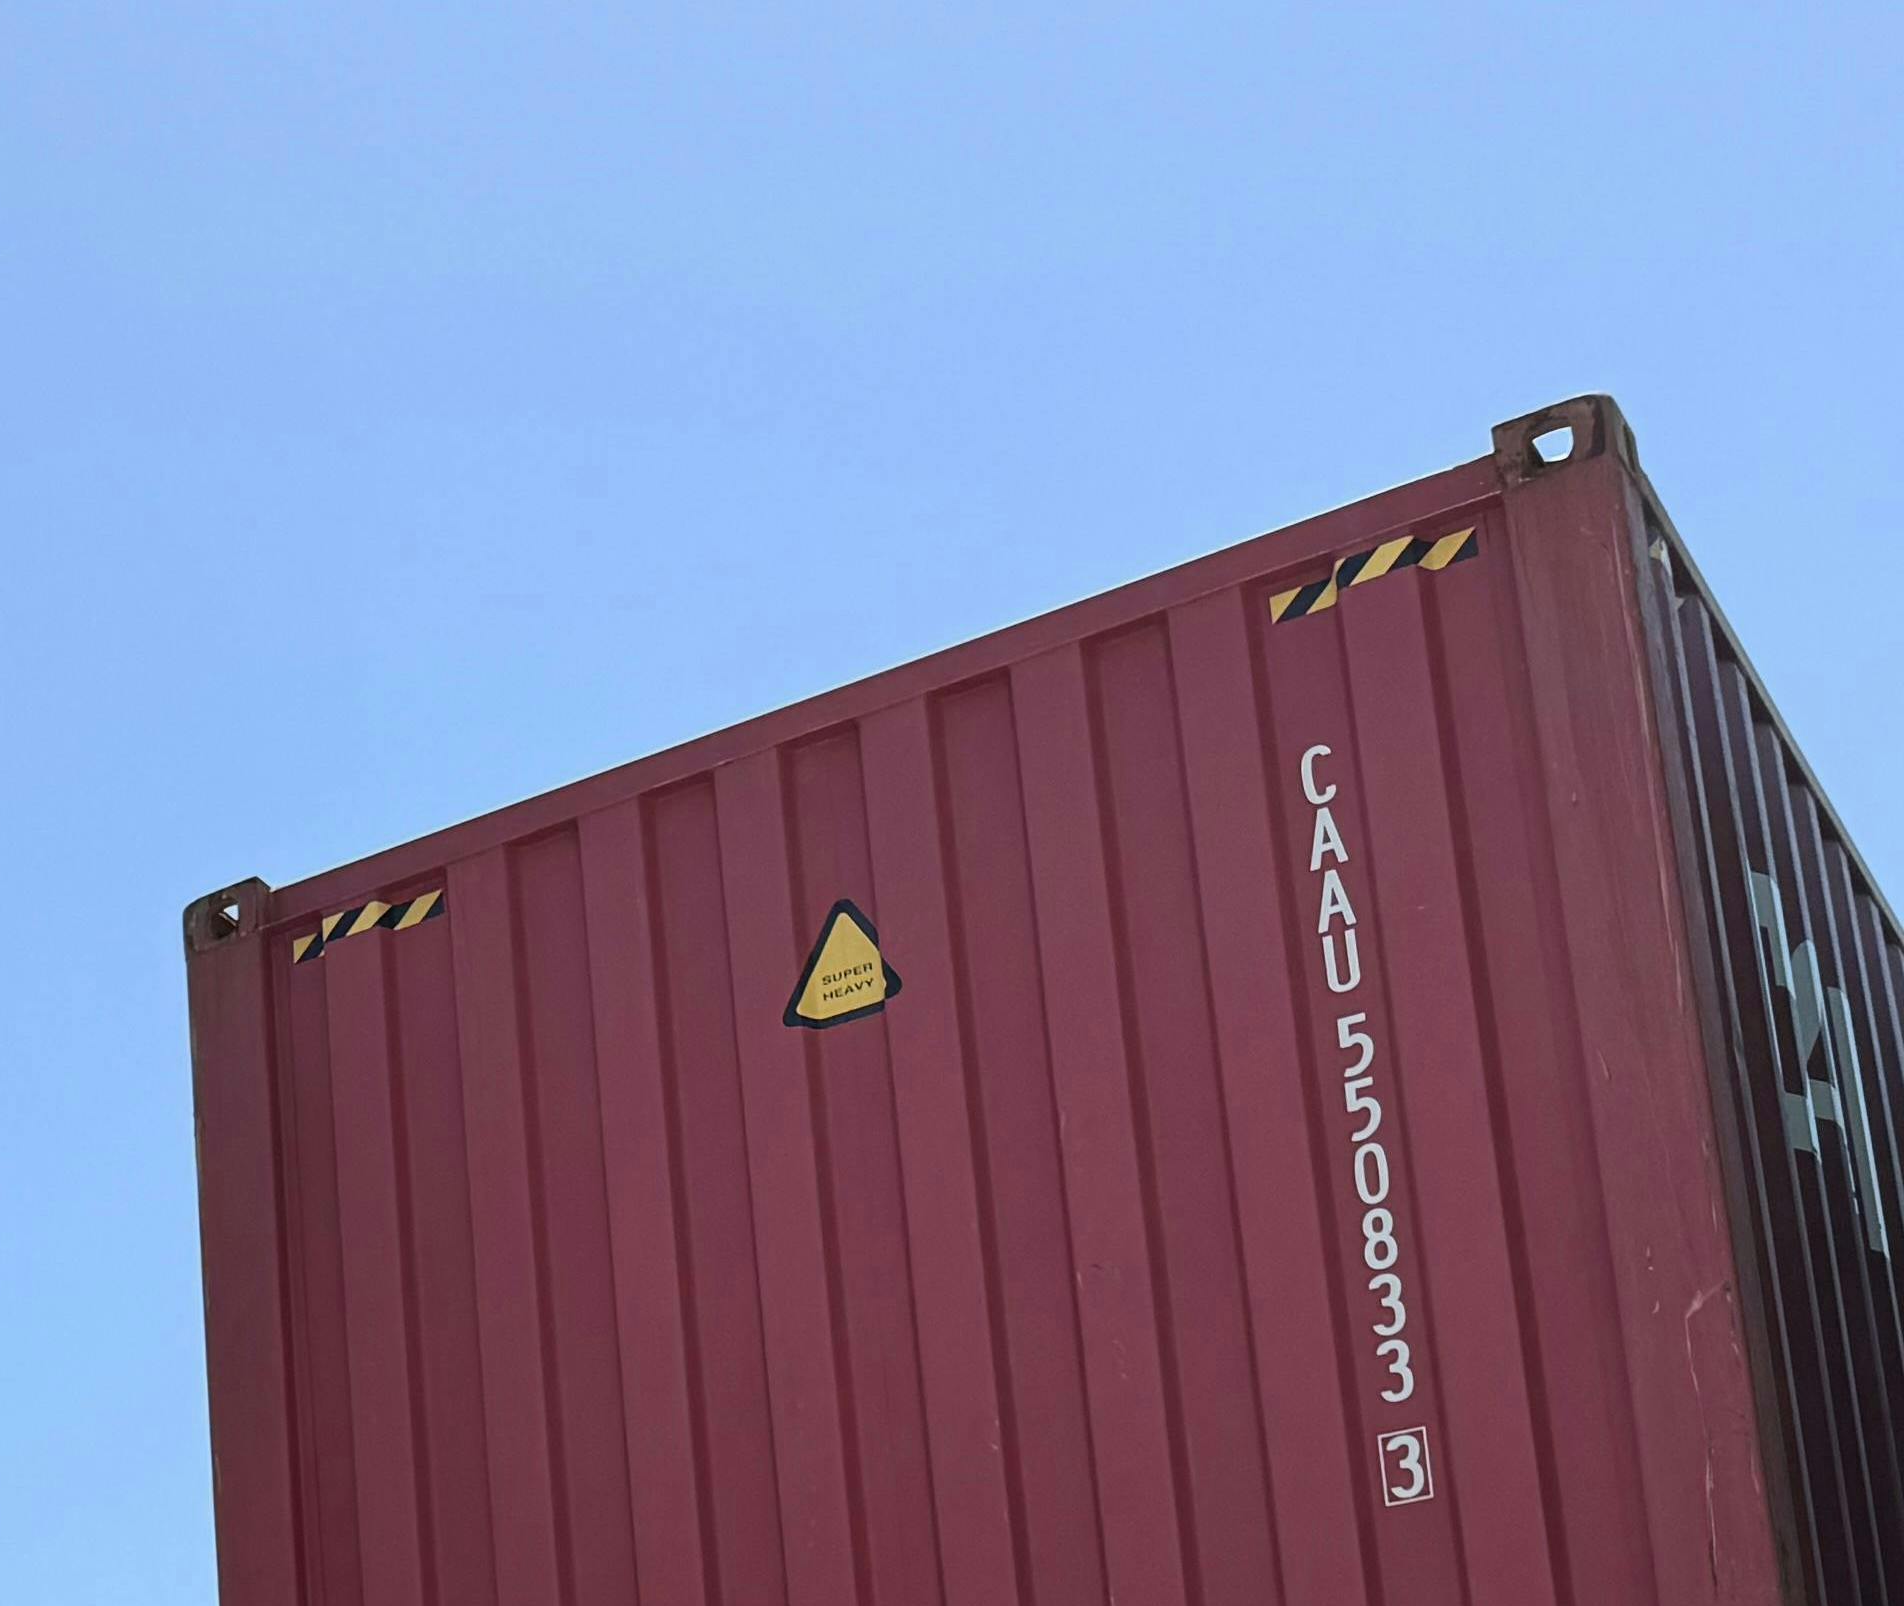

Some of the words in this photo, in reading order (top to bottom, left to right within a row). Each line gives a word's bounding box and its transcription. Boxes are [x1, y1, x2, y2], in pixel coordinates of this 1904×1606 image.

[822, 962, 873, 986] SUPER
[823, 977, 874, 1001] HEAVY
[1301, 744, 1361, 993] CAAU
[1337, 1011, 1414, 1403] 550833
[1387, 1433, 1425, 1500] 3
